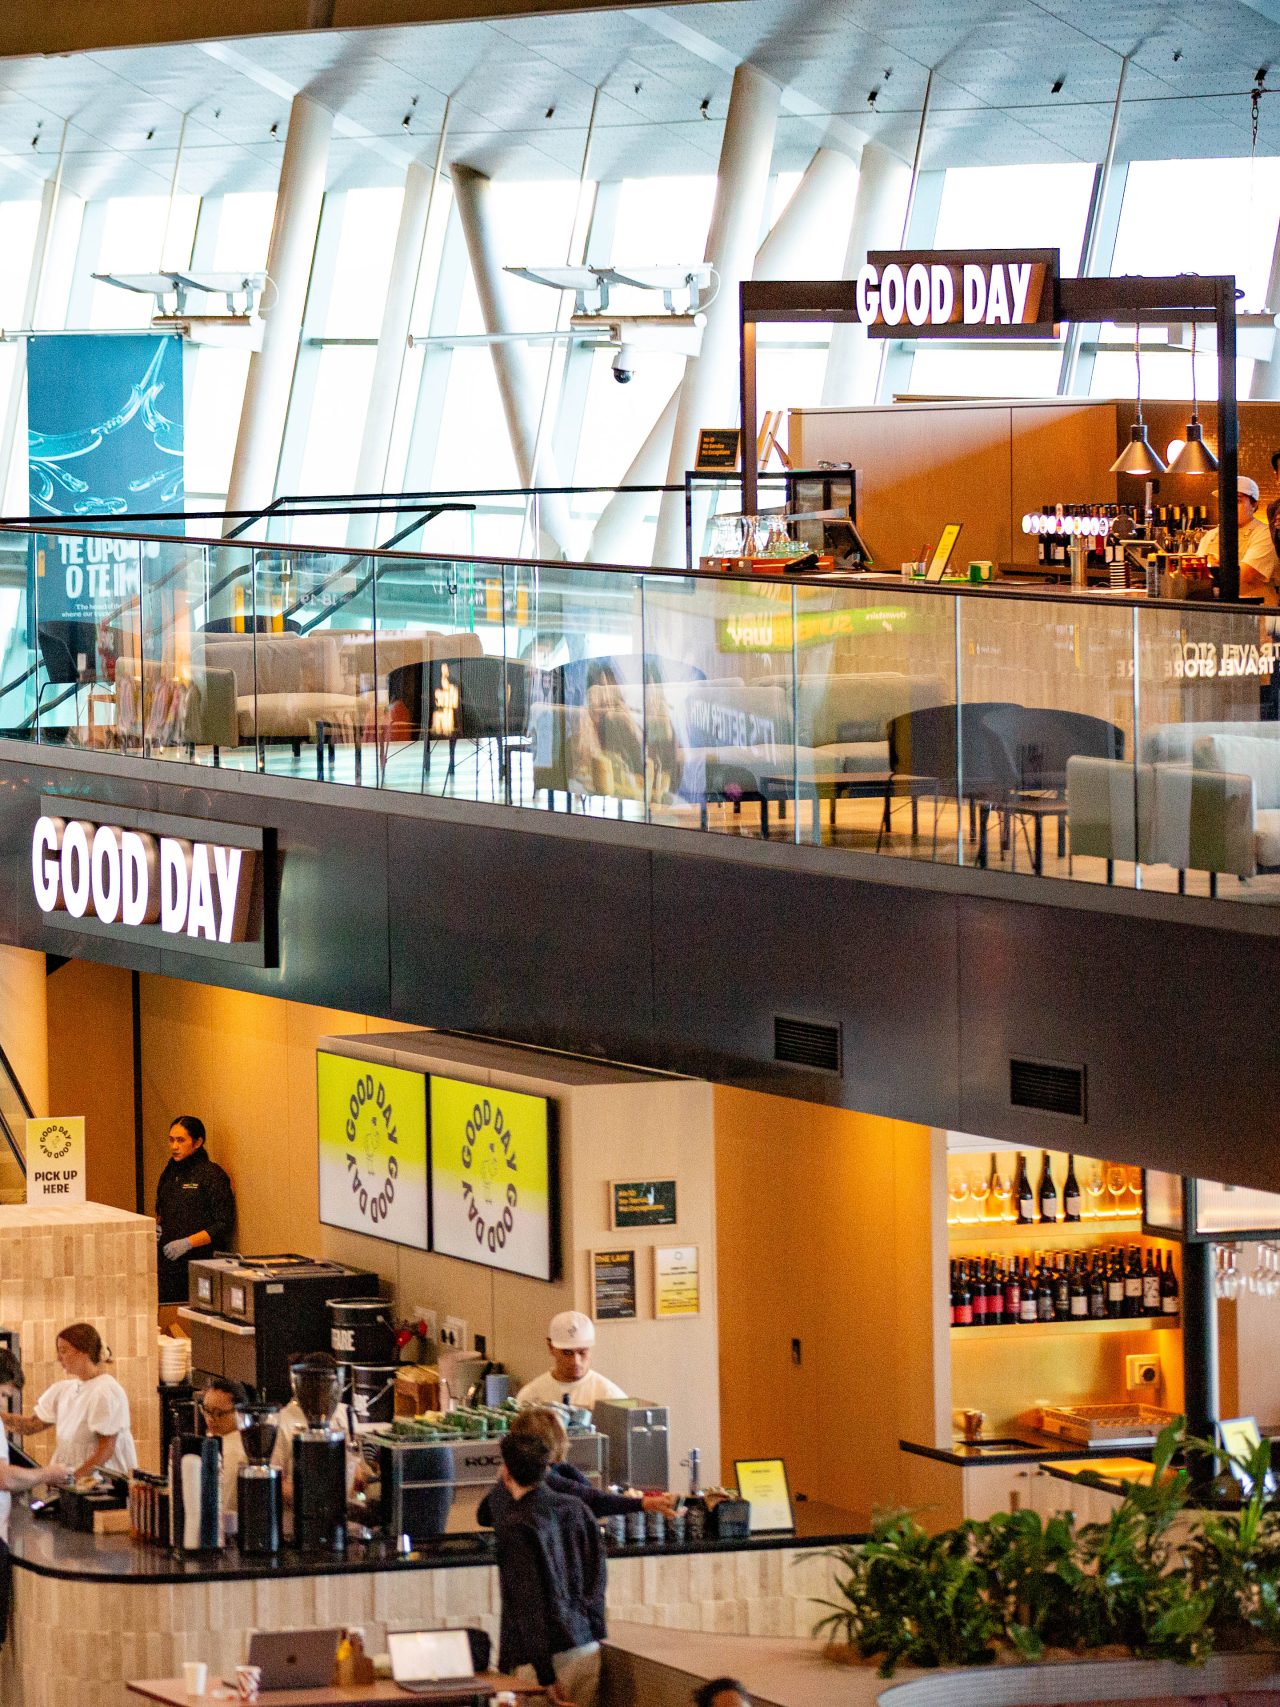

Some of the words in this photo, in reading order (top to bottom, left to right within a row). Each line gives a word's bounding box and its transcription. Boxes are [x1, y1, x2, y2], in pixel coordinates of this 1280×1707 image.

[856, 263, 954, 326] GOOD
[964, 263, 1032, 325] DAY
[58, 535, 84, 564] TE
[65, 565, 83, 598] O
[86, 563, 111, 598] TE
[32, 816, 149, 926] GOOD
[160, 837, 242, 944] DAY
[40, 1125, 57, 1142] GOOD
[58, 1126, 71, 1140] DAY
[346, 1074, 373, 1142] GOOD
[376, 1081, 398, 1144] DAY
[462, 1099, 491, 1169] GOOD
[40, 1144, 53, 1158] DAY
[53, 1141, 71, 1159] GOOD
[494, 1107, 517, 1172] DAY
[34, 1171, 60, 1181] PICK
[63, 1170, 77, 1180] UP
[43, 1183, 69, 1194] HERE
[346, 1153, 368, 1215] DAY
[371, 1155, 398, 1224] GOOD
[462, 1180, 485, 1244] DAY
[487, 1183, 517, 1253] GOOD
[465, 1456, 502, 1466] ROC
